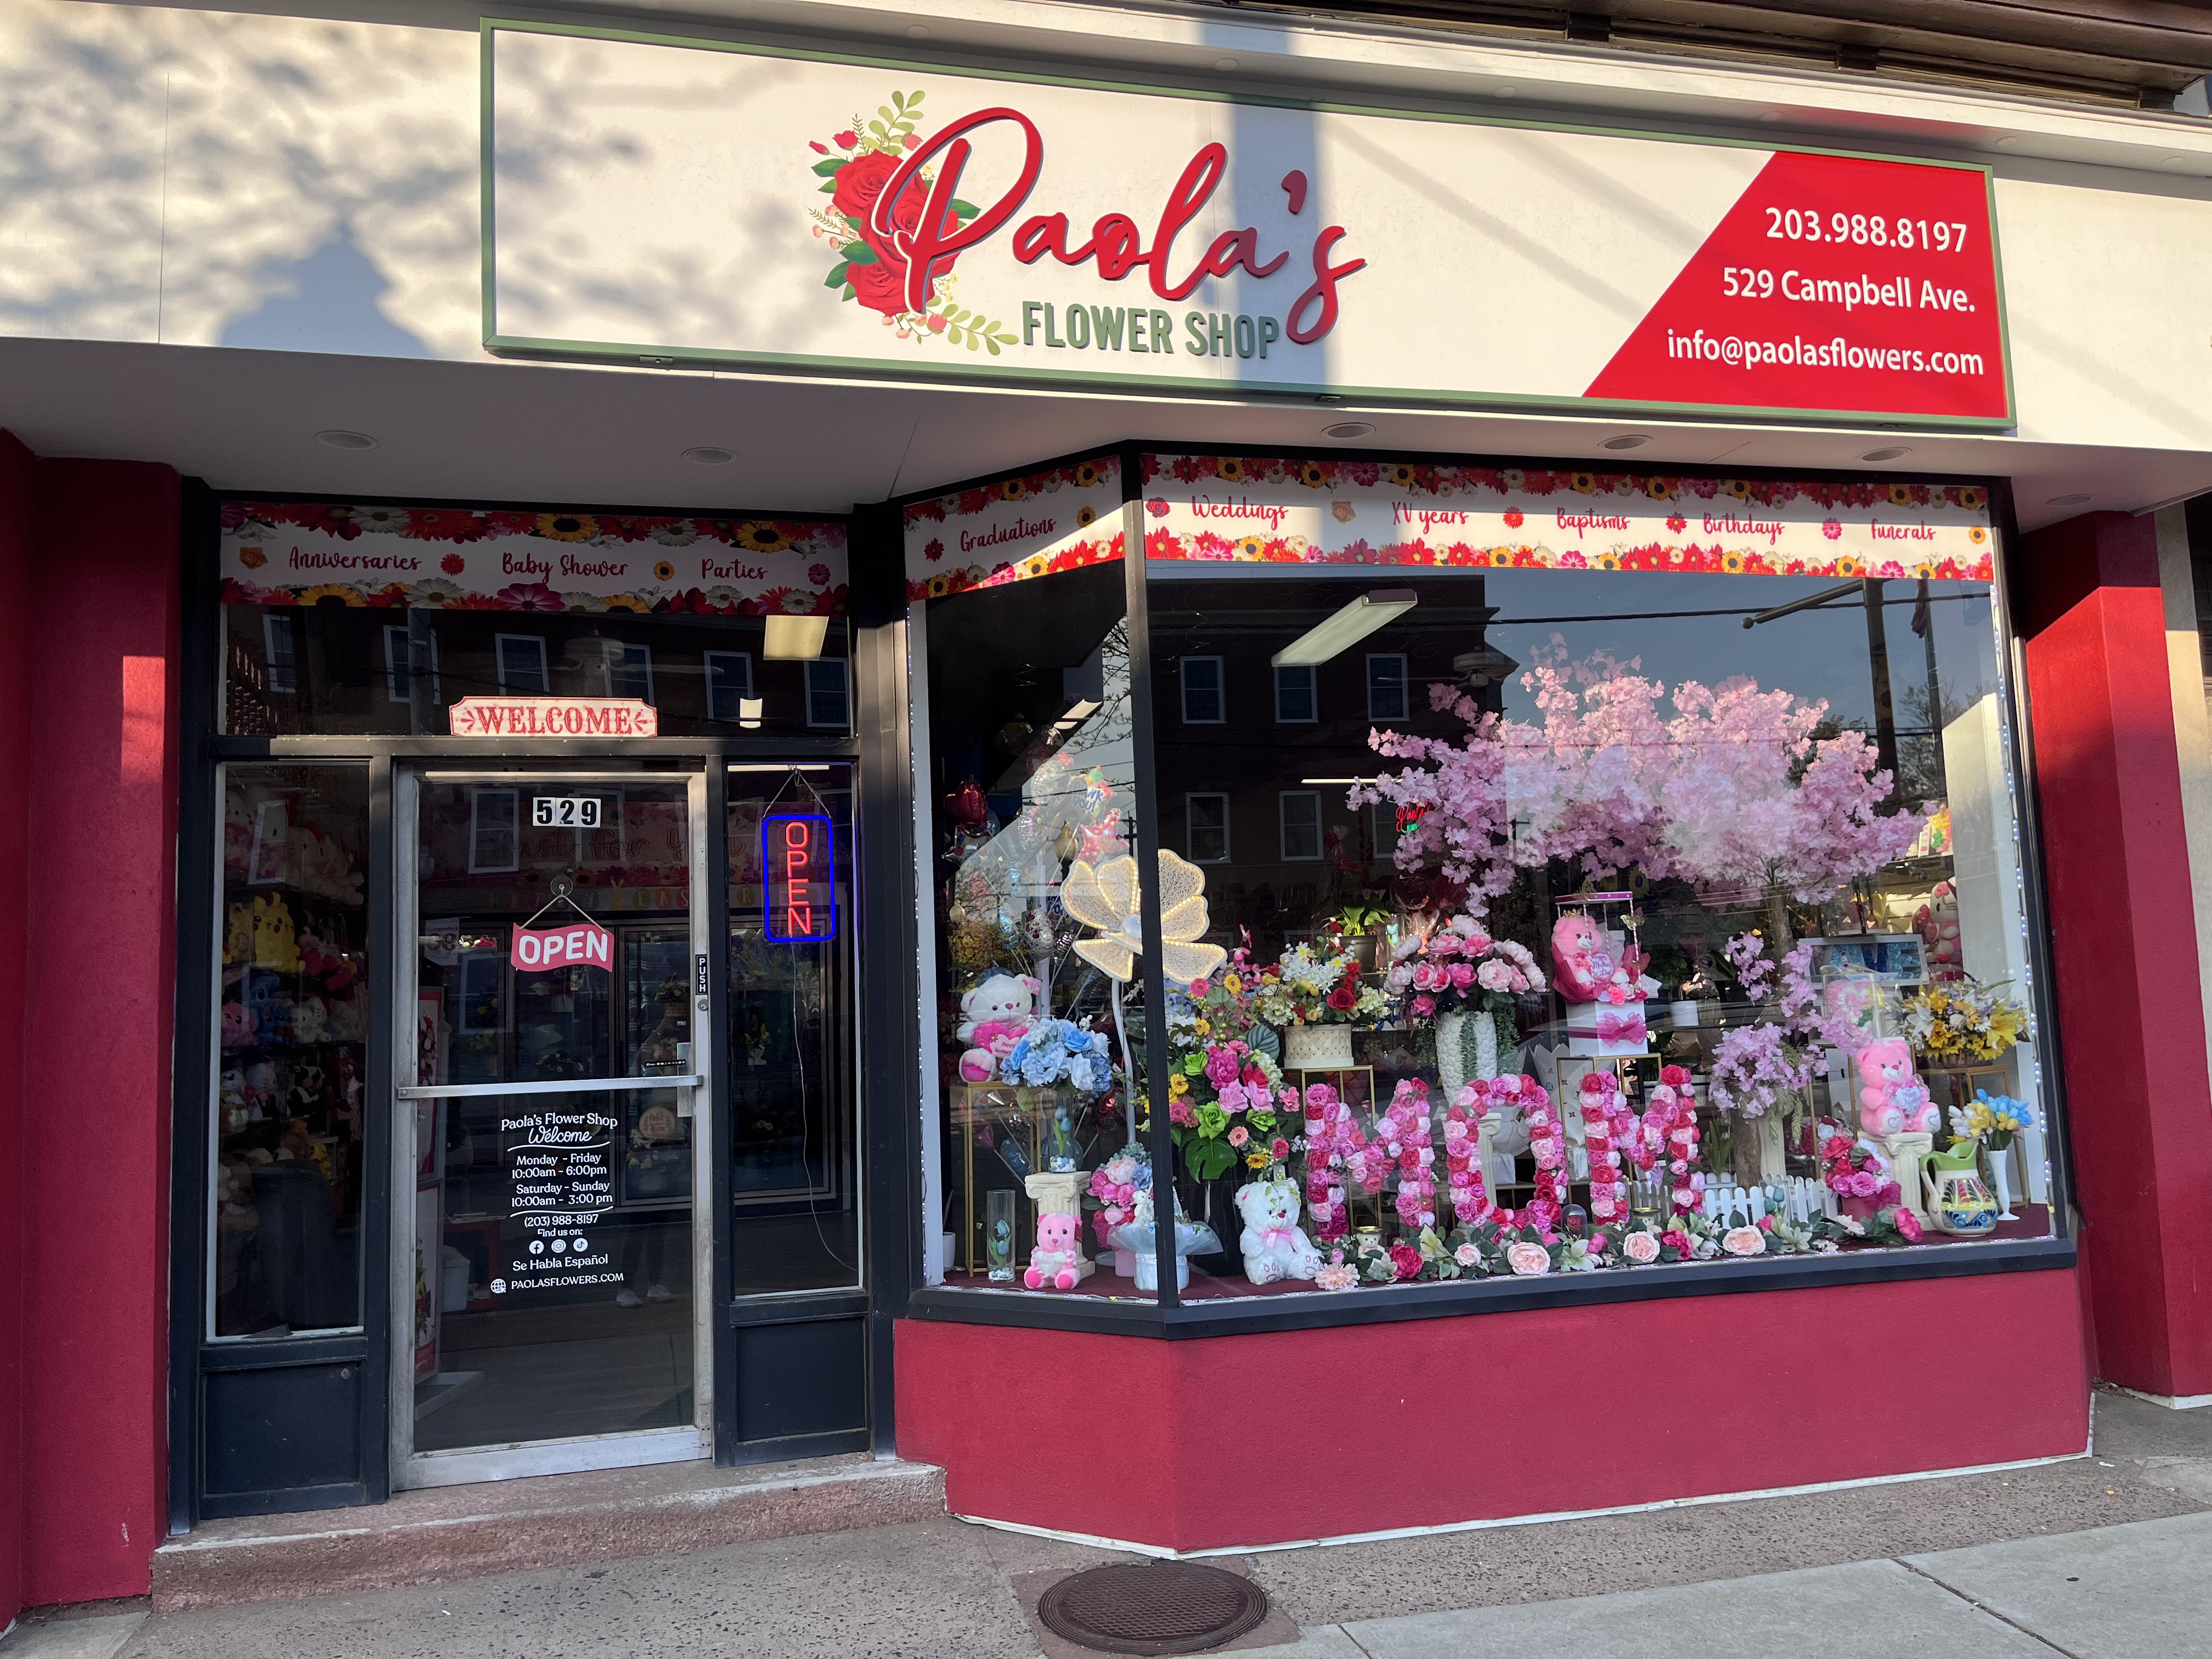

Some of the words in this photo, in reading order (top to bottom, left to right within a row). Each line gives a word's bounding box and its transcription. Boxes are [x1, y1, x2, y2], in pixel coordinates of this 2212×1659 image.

[871, 106, 1367, 345] Paola's
[1765, 207, 1967, 252] 203.988.8197
[1723, 267, 1774, 298] 529
[1781, 270, 1912, 311] Campbell
[1920, 280, 1975, 312] Ave.
[1022, 300, 1173, 355] FLOWER
[1184, 311, 1280, 359] SHOP
[1667, 329, 1983, 375] info@paolasflowers.com
[1191, 494, 1289, 531] Weddings
[1392, 501, 1412, 525] XV
[1419, 510, 1469, 534] years
[1556, 507, 1630, 539] Baptisms
[960, 517, 1057, 552] Graduations
[1703, 512, 1785, 545] Birthdays
[289, 546, 422, 571] Anniversaries
[502, 552, 553, 584] Baby
[560, 554, 628, 576] Shower
[702, 558, 768, 580] Parties
[474, 706, 633, 735] WELCOME
[537, 798, 597, 826] 529
[786, 822, 811, 934] OPEN
[518, 930, 608, 965] OPEN
[501, 1114, 542, 1131] Paola's
[545, 1113, 585, 1125] Flower
[587, 1113, 618, 1129] Shop
[528, 1126, 592, 1144] Welcome
[512, 1168, 556, 1179] 10:00am
[566, 1165, 607, 1177] 6:00pm
[516, 1154, 557, 1167] Monday
[571, 1153, 601, 1164] Friday
[511, 1197, 556, 1207] 10:00am
[568, 1194, 593, 1205] 3:00
[596, 1195, 613, 1205] pm
[516, 1183, 562, 1194] Saturday
[572, 1181, 610, 1192] Sunday
[524, 1216, 550, 1227] (203)
[552, 1214, 599, 1225] 988-8197
[512, 1261, 527, 1271] Se
[530, 1257, 562, 1270] Habla
[565, 1254, 608, 1268] Español
[511, 1273, 624, 1289] PAOLASFLOWERS.COM
